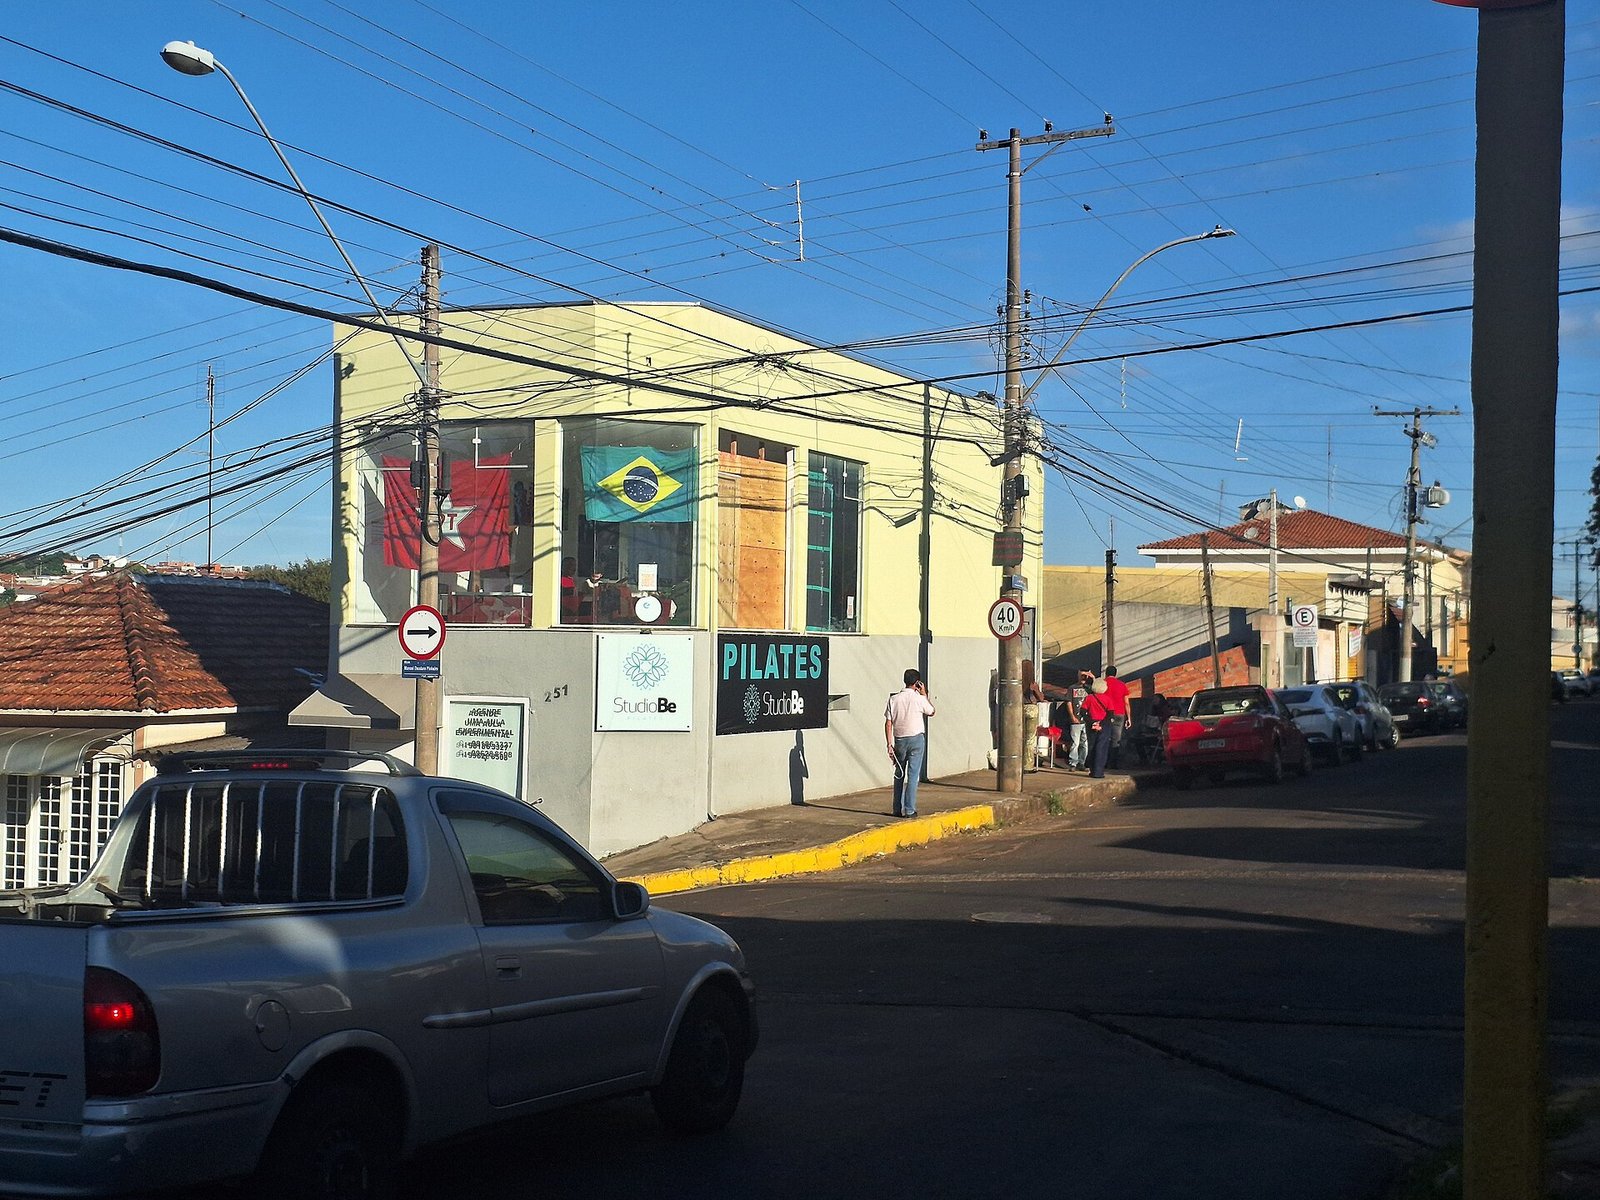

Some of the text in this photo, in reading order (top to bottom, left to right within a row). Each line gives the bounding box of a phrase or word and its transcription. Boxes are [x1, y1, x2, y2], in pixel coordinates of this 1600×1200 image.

[997, 607, 1015, 623] 40
[1300, 611, 1309, 623] E
[723, 643, 822, 680] PILATES
[544, 684, 568, 703] 251
[468, 708, 502, 718] AGENDE
[613, 697, 677, 713] StudioBe
[455, 727, 515, 739] EXPERIMENTAL
